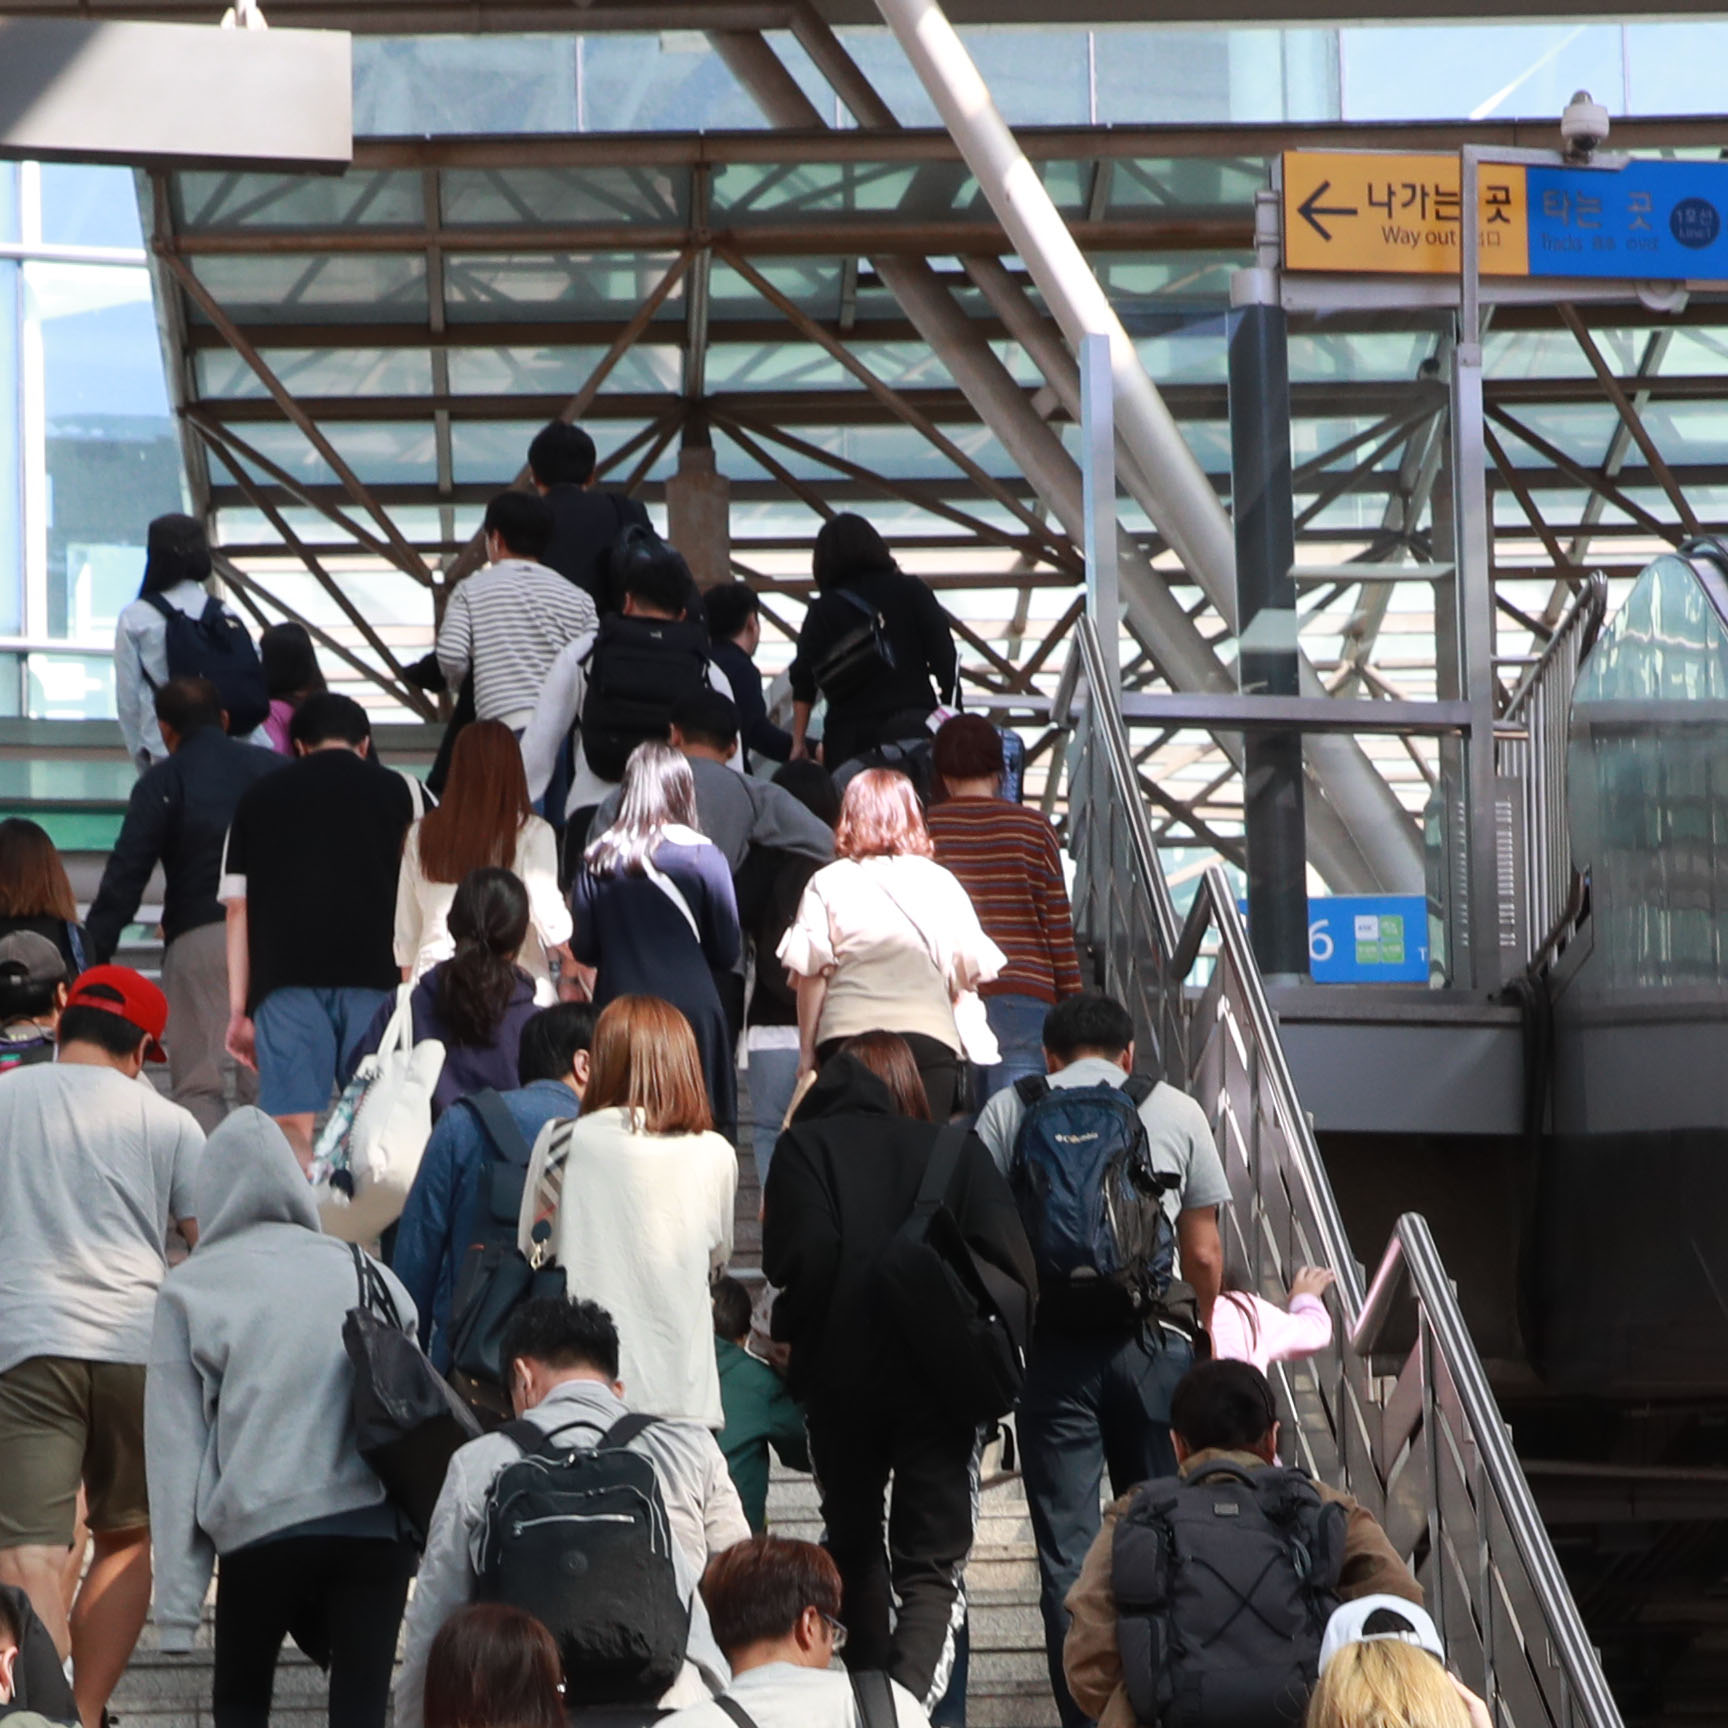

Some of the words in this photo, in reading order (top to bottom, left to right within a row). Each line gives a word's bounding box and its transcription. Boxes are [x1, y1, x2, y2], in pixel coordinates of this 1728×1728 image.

[1367, 182, 1460, 221] 나가는
[1485, 184, 1512, 224] 곳
[1542, 188, 1603, 229] 타는
[1626, 190, 1654, 231] 곳
[1381, 225, 1420, 249] Way
[1424, 229, 1457, 246] out
